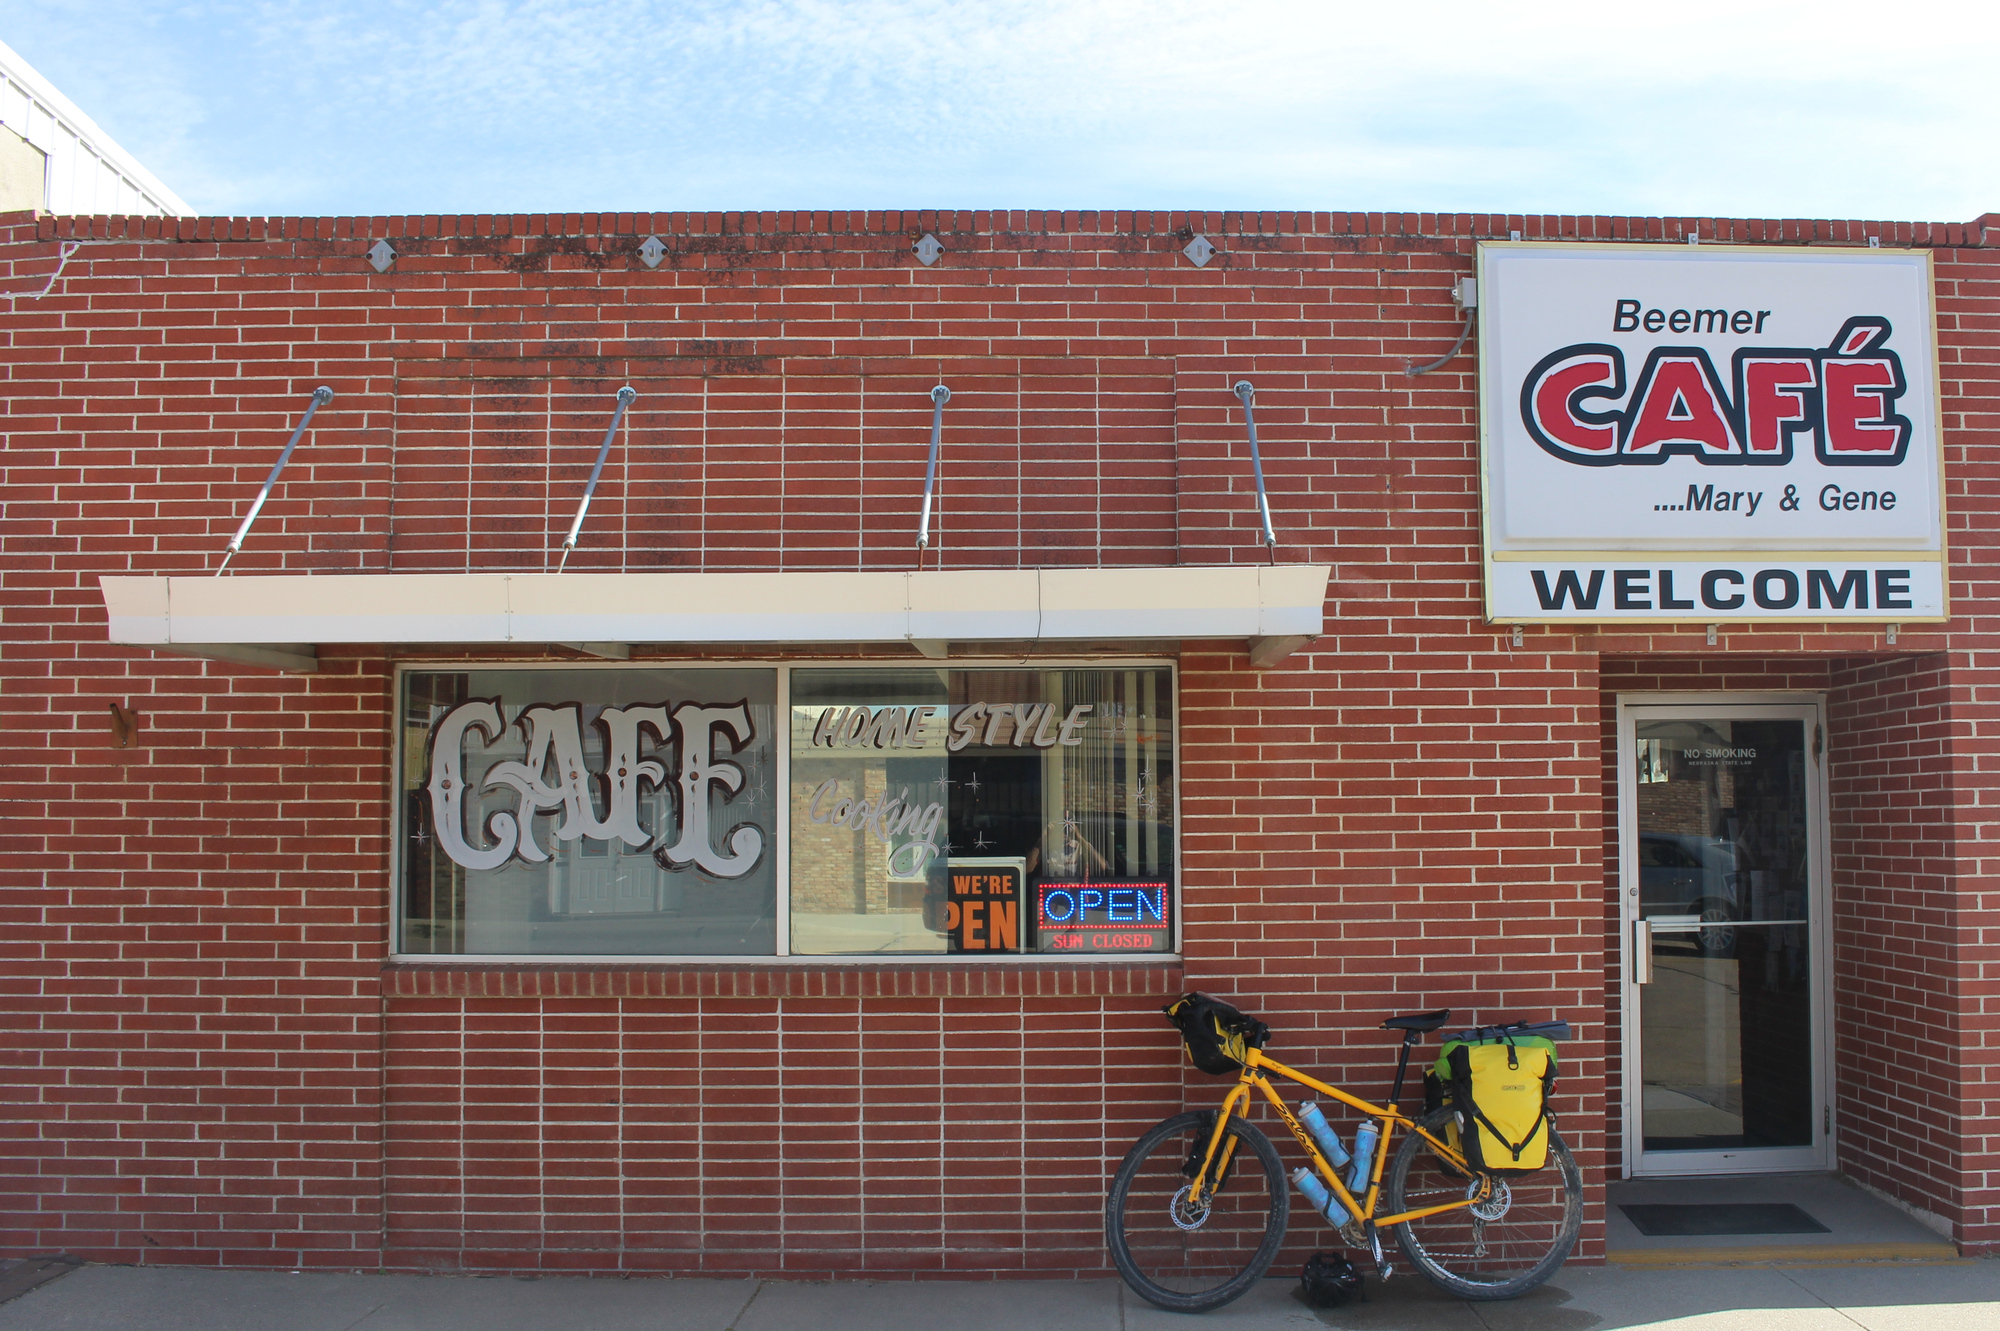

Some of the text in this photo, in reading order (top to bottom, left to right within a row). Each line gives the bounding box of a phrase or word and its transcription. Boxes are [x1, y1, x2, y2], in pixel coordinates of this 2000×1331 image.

[1612, 299, 1771, 334] Beemer
[1520, 315, 1912, 467] CAFÉ
[1779, 484, 1800, 512] &
[1818, 484, 1897, 511] Gene
[1530, 568, 1913, 611] WELCOME
[812, 701, 1094, 754] HOME STYLE
[1683, 748, 1757, 759] NO SMOKING
[427, 696, 766, 878] CAFE
[809, 778, 944, 878] Cooking
[953, 875, 1013, 895] WE'RE
[1044, 888, 1163, 922] OPEN
[1052, 933, 1153, 949] SUN CLOSED
